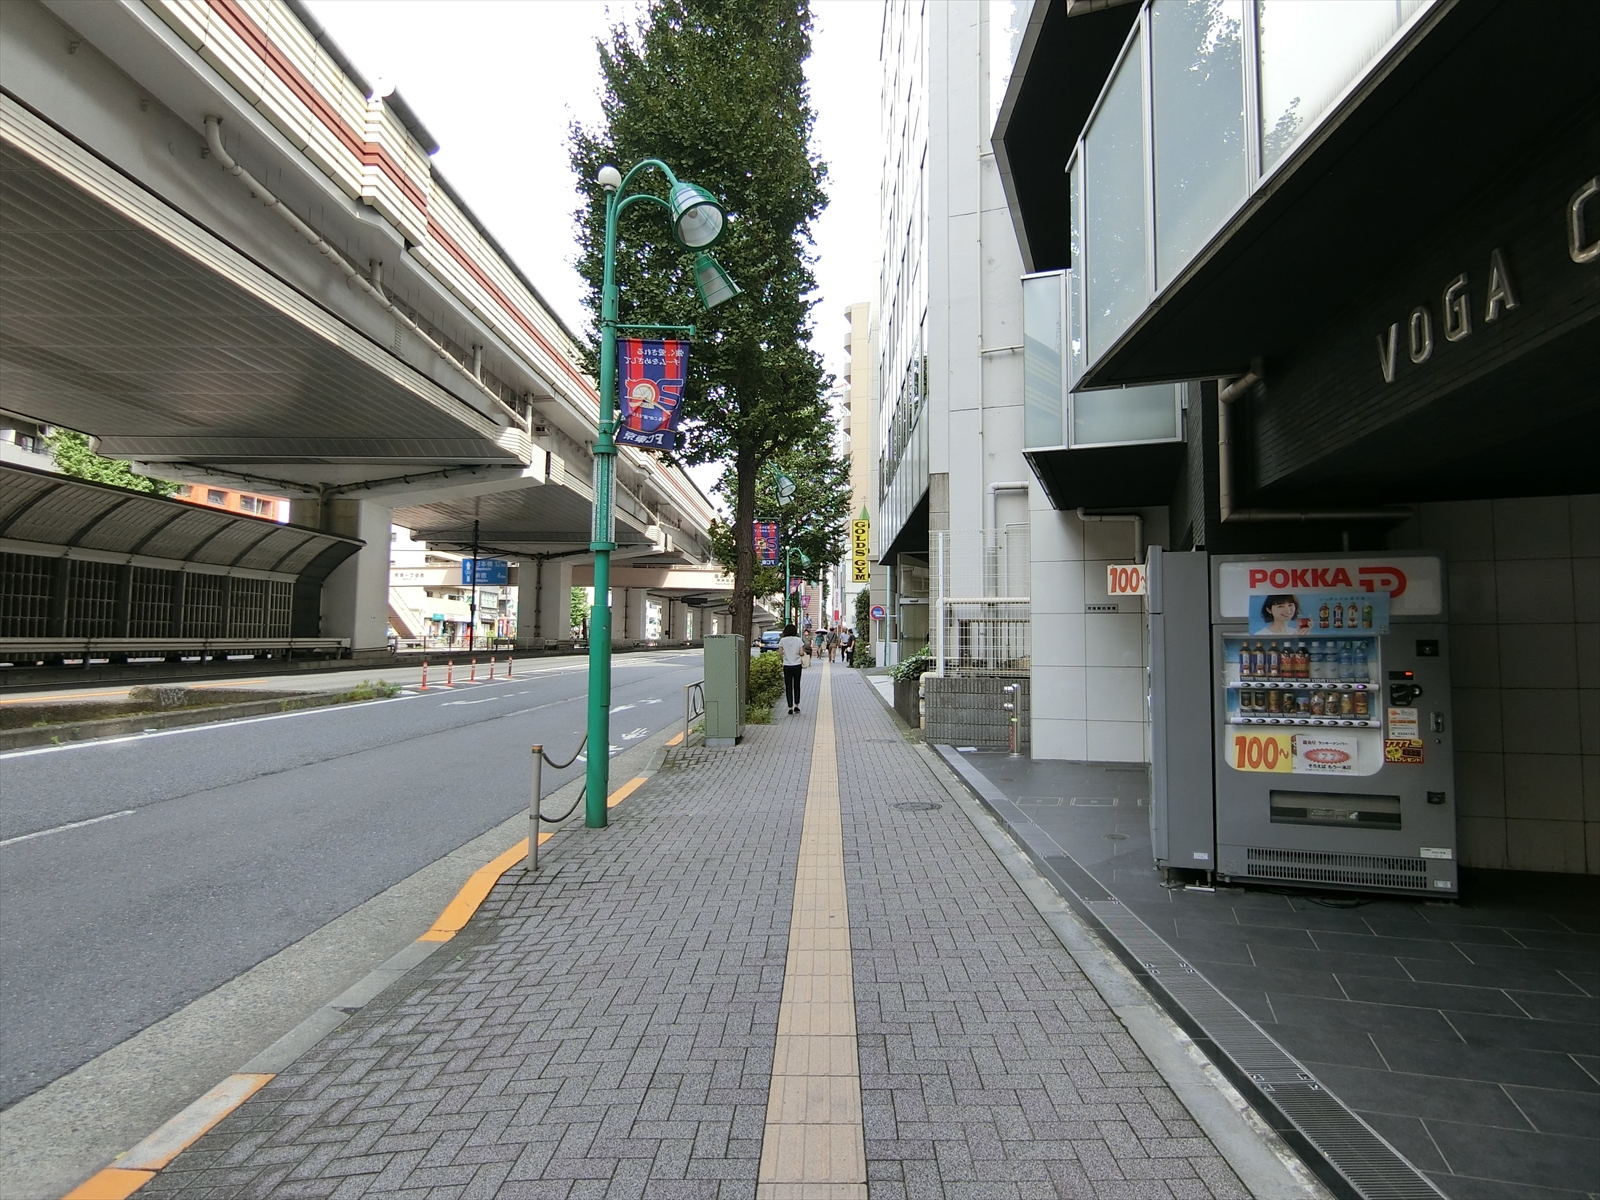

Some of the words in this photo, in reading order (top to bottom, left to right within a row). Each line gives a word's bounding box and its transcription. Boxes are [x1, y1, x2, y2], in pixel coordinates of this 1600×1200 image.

[1376, 247, 1519, 383] VOGA
[854, 521, 867, 556] GOLD'S
[854, 559, 867, 580] GYM
[1249, 568, 1352, 588] POKKA
